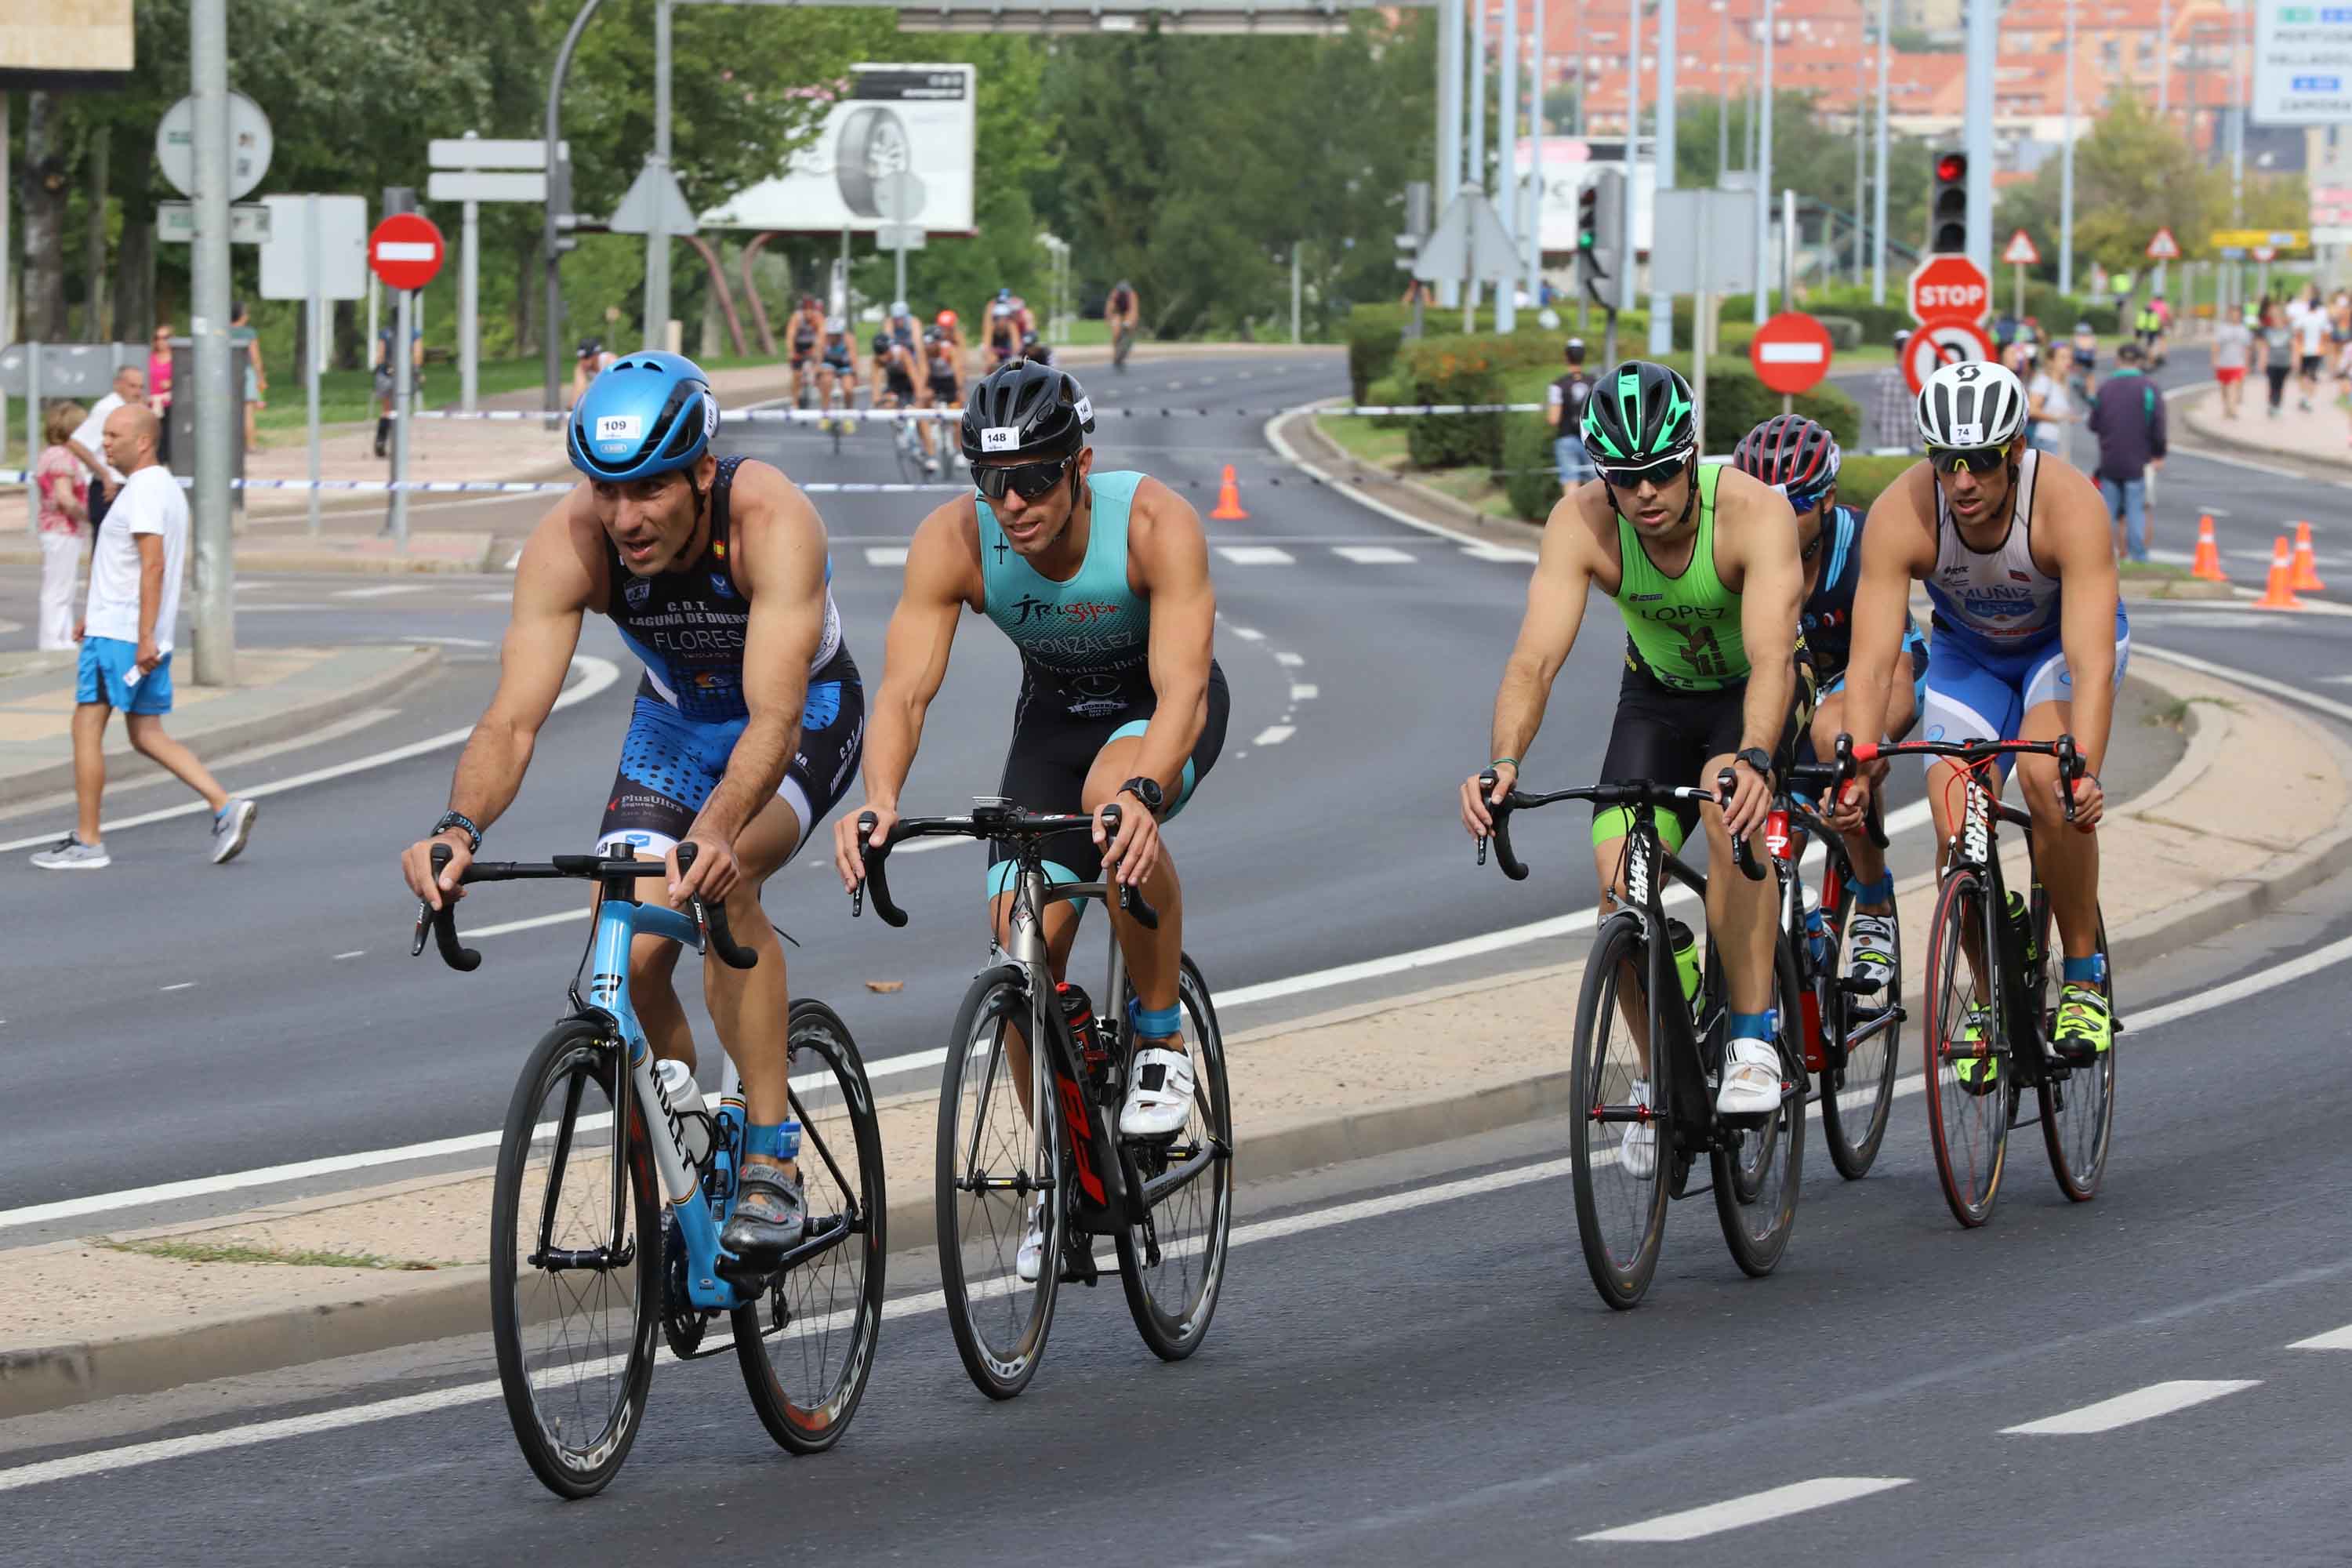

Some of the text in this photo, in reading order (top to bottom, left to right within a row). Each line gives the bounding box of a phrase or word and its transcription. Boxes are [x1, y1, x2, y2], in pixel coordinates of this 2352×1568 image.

[1918, 285, 1984, 307] STOP
[603, 421, 626, 430] 109
[987, 433, 1007, 443] 148
[1955, 584, 2031, 600] MUÑIZ
[629, 612, 685, 626] LAGUNA
[687, 612, 706, 624] DE
[1641, 605, 1726, 622] LOPEZ
[653, 630, 745, 651] FLORES
[621, 793, 684, 815] PlusUltra
[649, 1065, 691, 1172] RIDLEY
